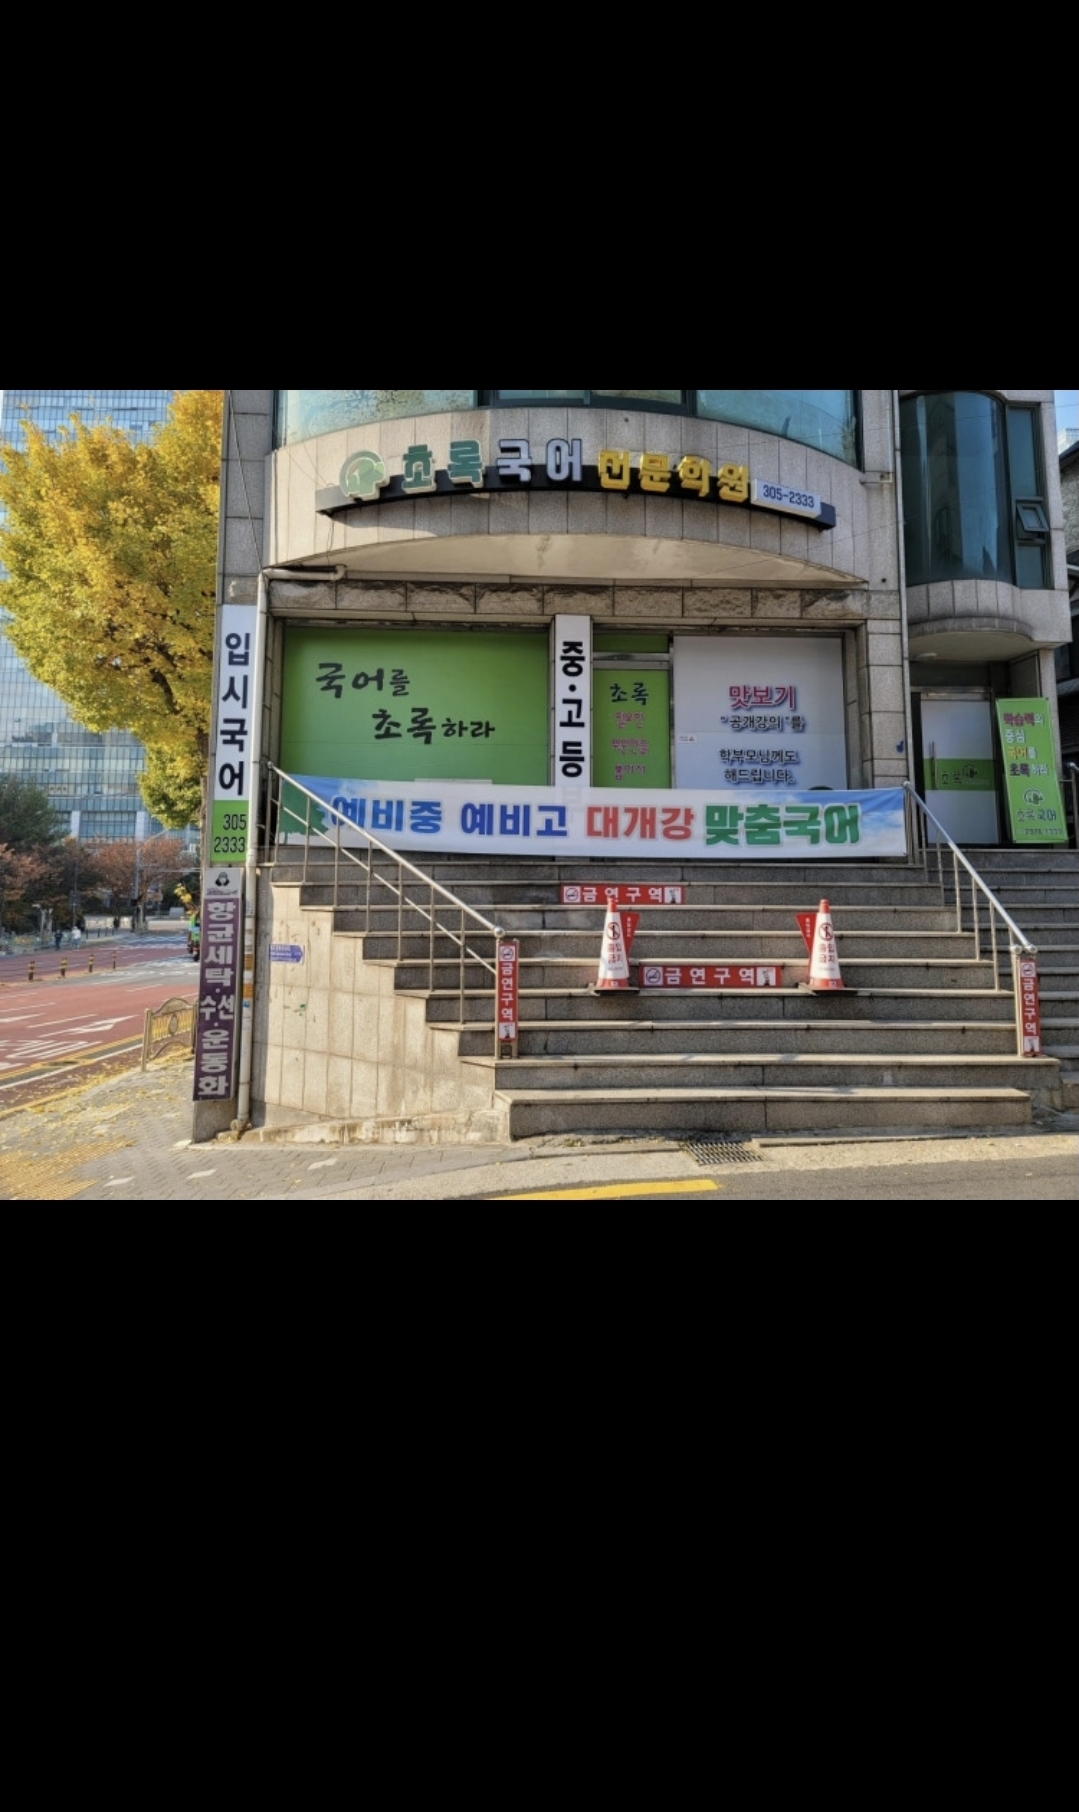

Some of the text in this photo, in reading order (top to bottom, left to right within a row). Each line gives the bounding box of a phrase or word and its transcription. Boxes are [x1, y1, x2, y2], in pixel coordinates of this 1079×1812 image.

[763, 484, 815, 508] 305-2333
[316, 663, 410, 699] 국어를
[610, 682, 649, 705] 초록
[729, 685, 796, 709] 맛보기
[219, 633, 250, 796] 입시국어
[223, 814, 247, 830] 305
[331, 797, 860, 845] 예비중 예비고 대개강 맞춤국어
[214, 837, 246, 853] 2333
